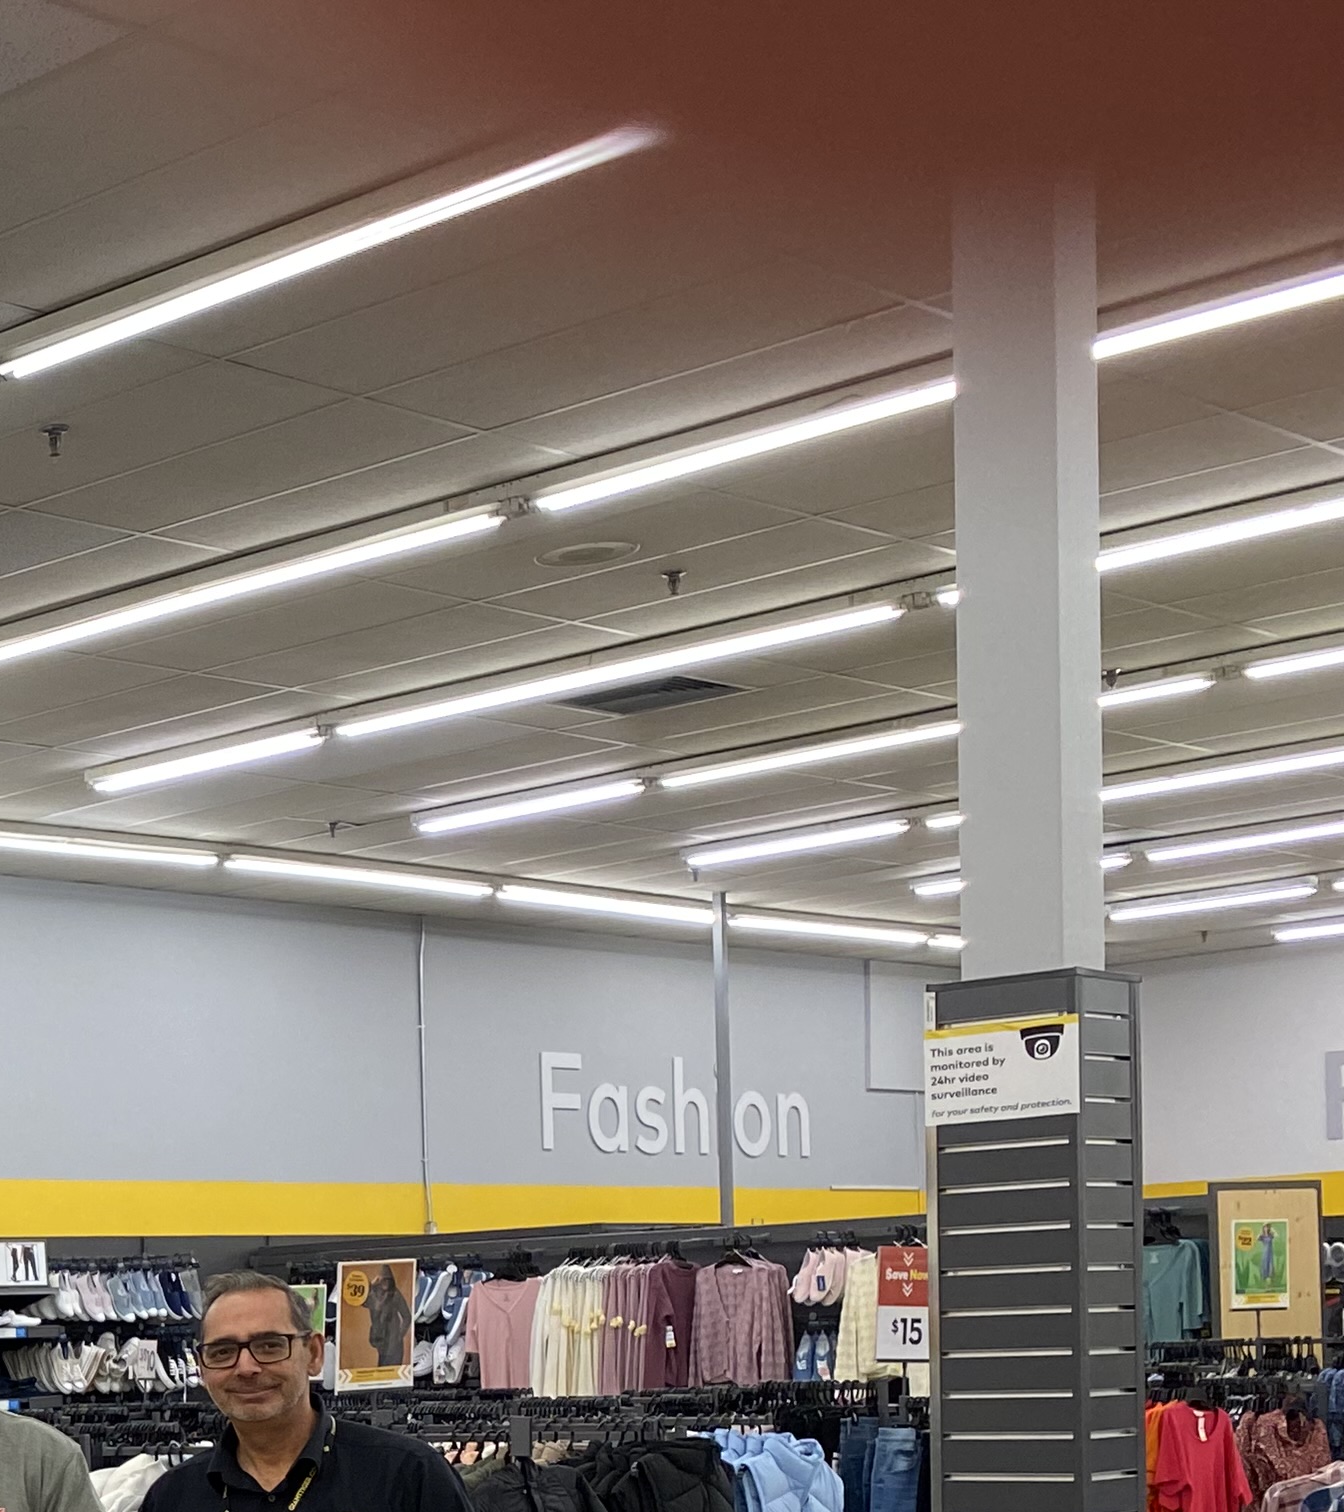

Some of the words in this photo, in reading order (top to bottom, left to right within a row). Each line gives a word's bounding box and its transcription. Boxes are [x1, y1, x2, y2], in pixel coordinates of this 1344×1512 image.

[930, 1047, 953, 1058] This
[957, 1046, 982, 1055] area
[984, 1043, 994, 1052] is
[930, 1057, 989, 1072] monitored
[992, 1056, 1006, 1067] by
[931, 1076, 955, 1086] 24hr
[958, 1073, 989, 1083] video
[931, 1087, 998, 1100] surveillance
[539, 1051, 811, 1158] Fashon
[931, 1110, 945, 1118] for
[947, 1107, 967, 1118] your
[970, 1105, 998, 1115] safety
[1001, 1103, 1019, 1111] and
[1021, 1098, 1072, 1111] protection.
[347, 1282, 365, 1297] $39
[891, 1318, 922, 1345] $15
